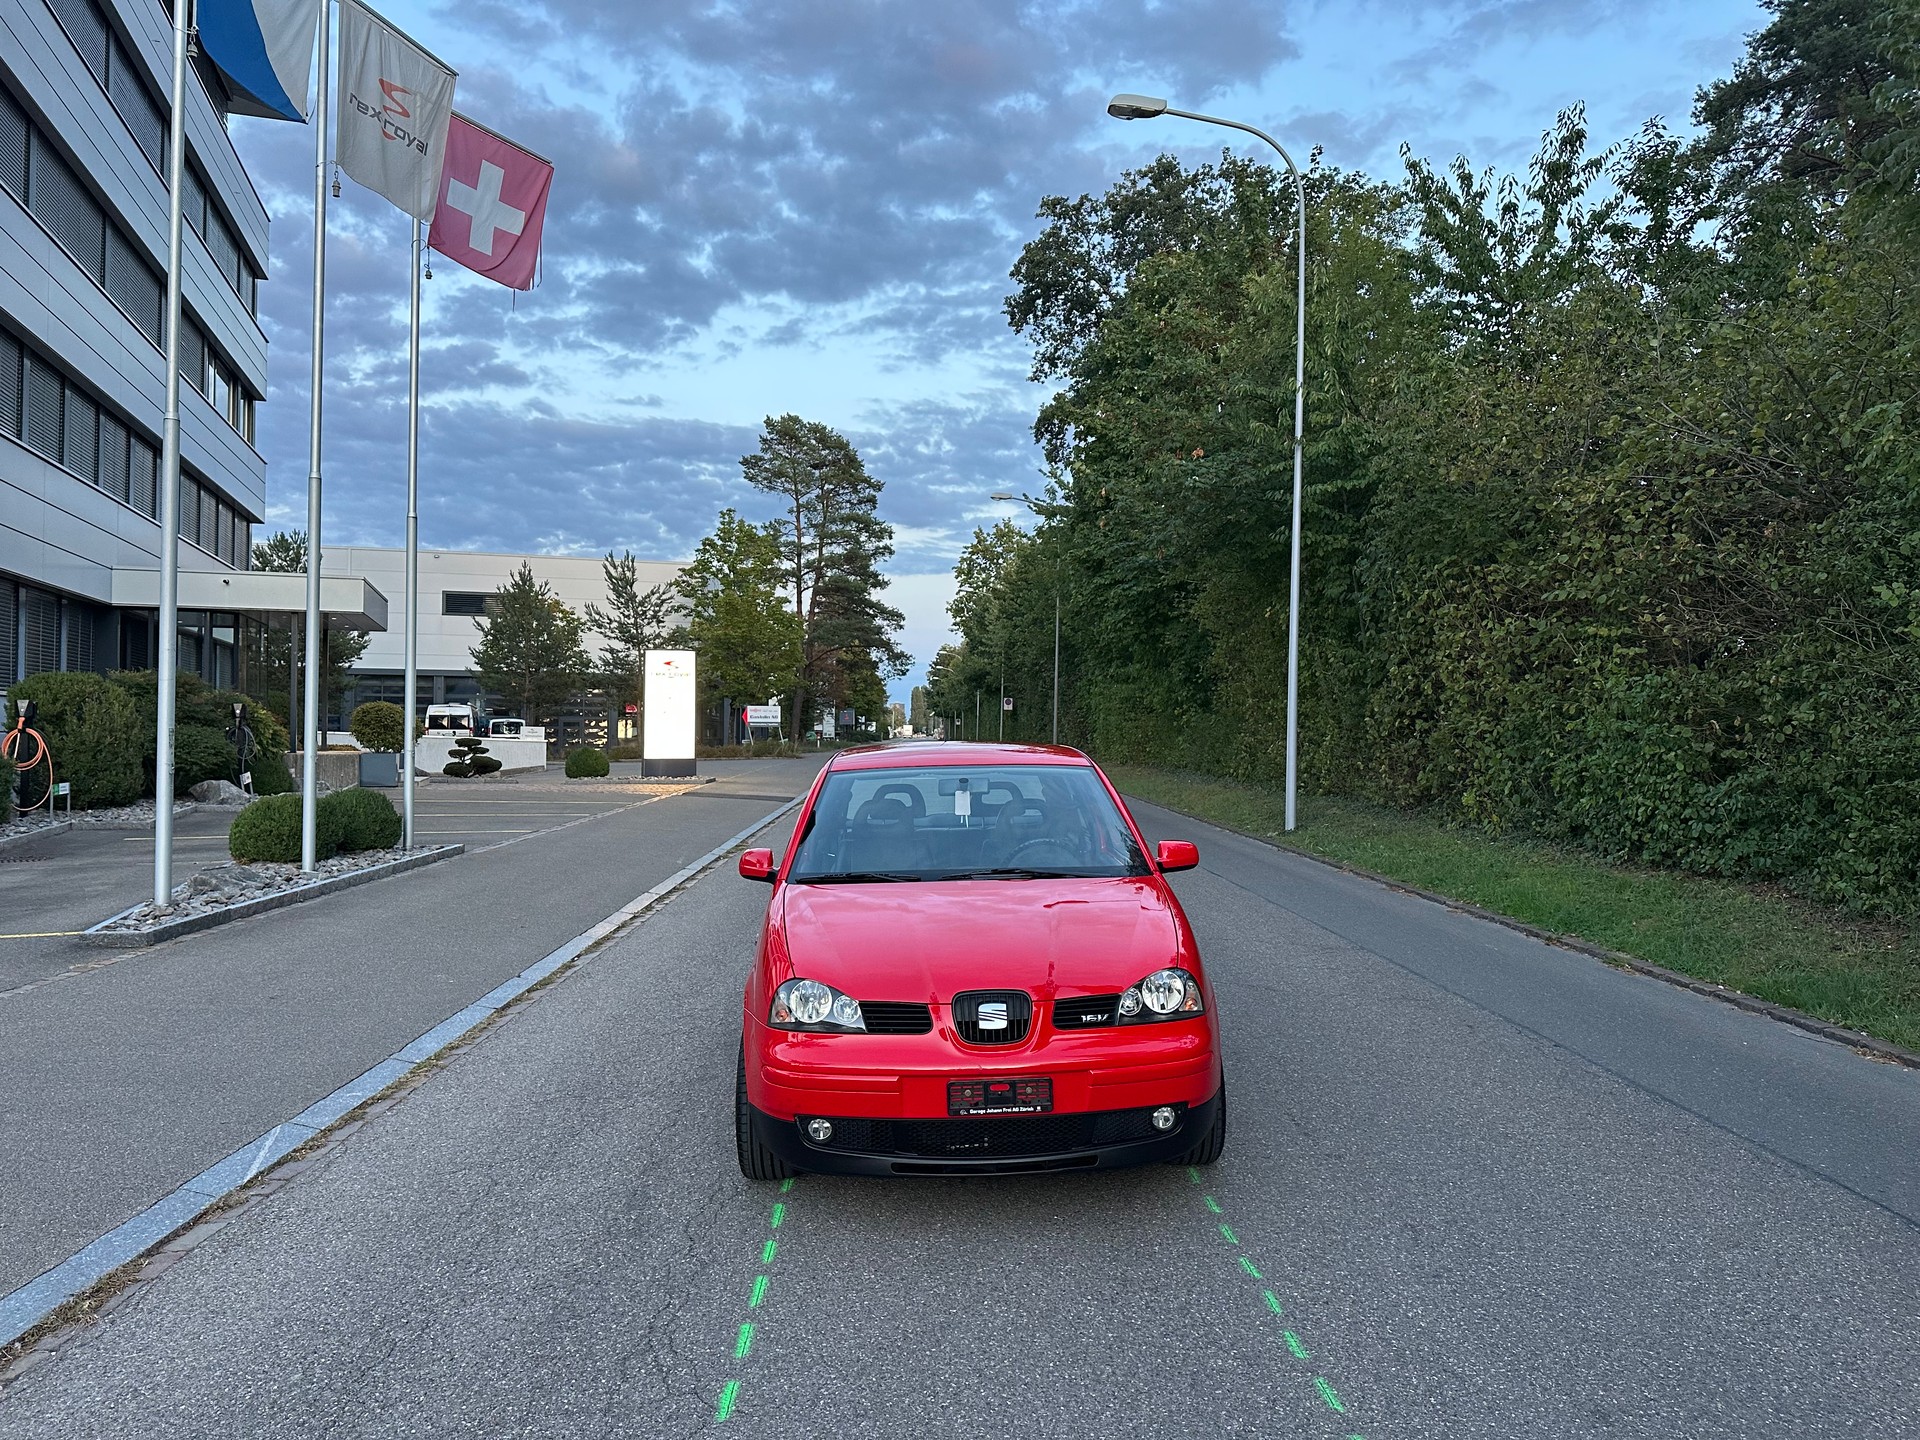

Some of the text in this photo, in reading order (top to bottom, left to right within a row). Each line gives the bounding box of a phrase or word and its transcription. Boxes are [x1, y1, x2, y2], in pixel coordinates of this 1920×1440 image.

[349, 92, 428, 156] rex royal
[1081, 1013, 1109, 1023] 16V
